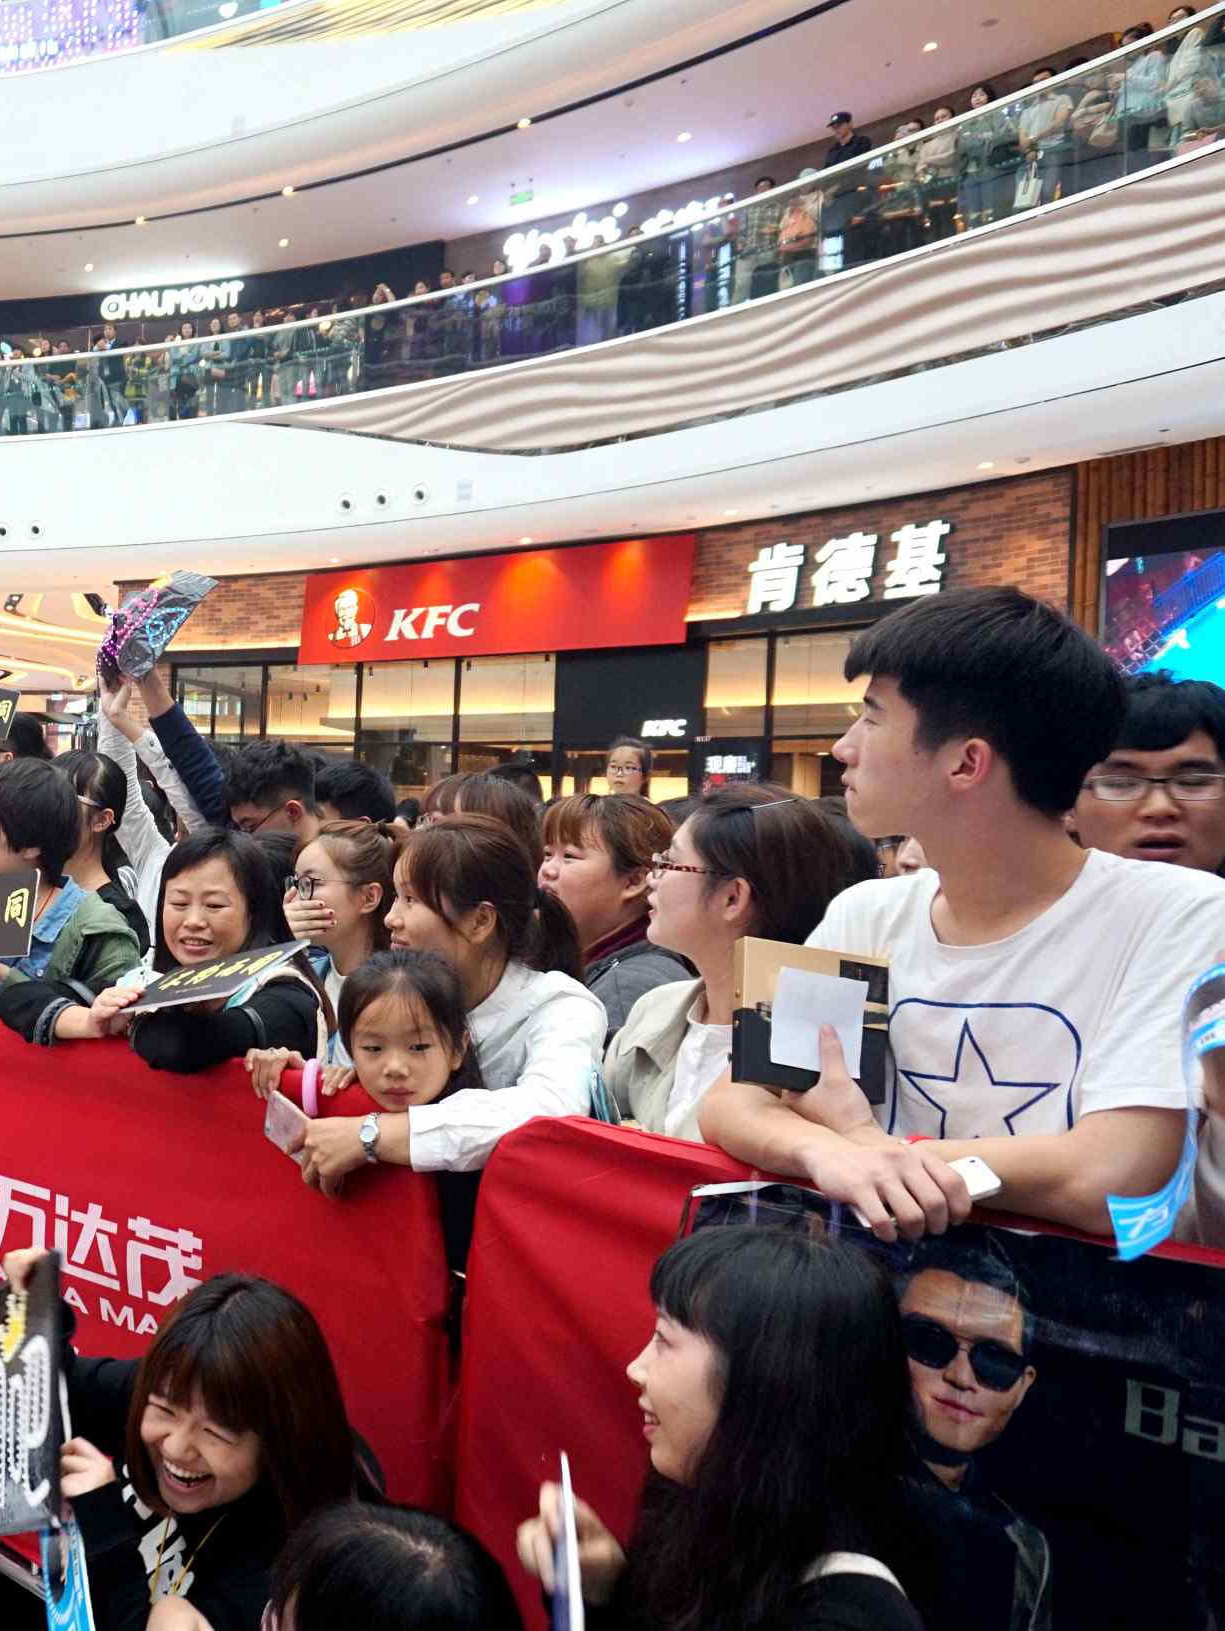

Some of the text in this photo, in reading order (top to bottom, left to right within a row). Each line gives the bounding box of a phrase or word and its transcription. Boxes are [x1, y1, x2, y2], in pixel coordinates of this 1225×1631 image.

[100, 280, 245, 321] CHAUMONT
[745, 519, 951, 616] 肯德基
[383, 602, 481, 641] KFC
[640, 718, 688, 738] KFC
